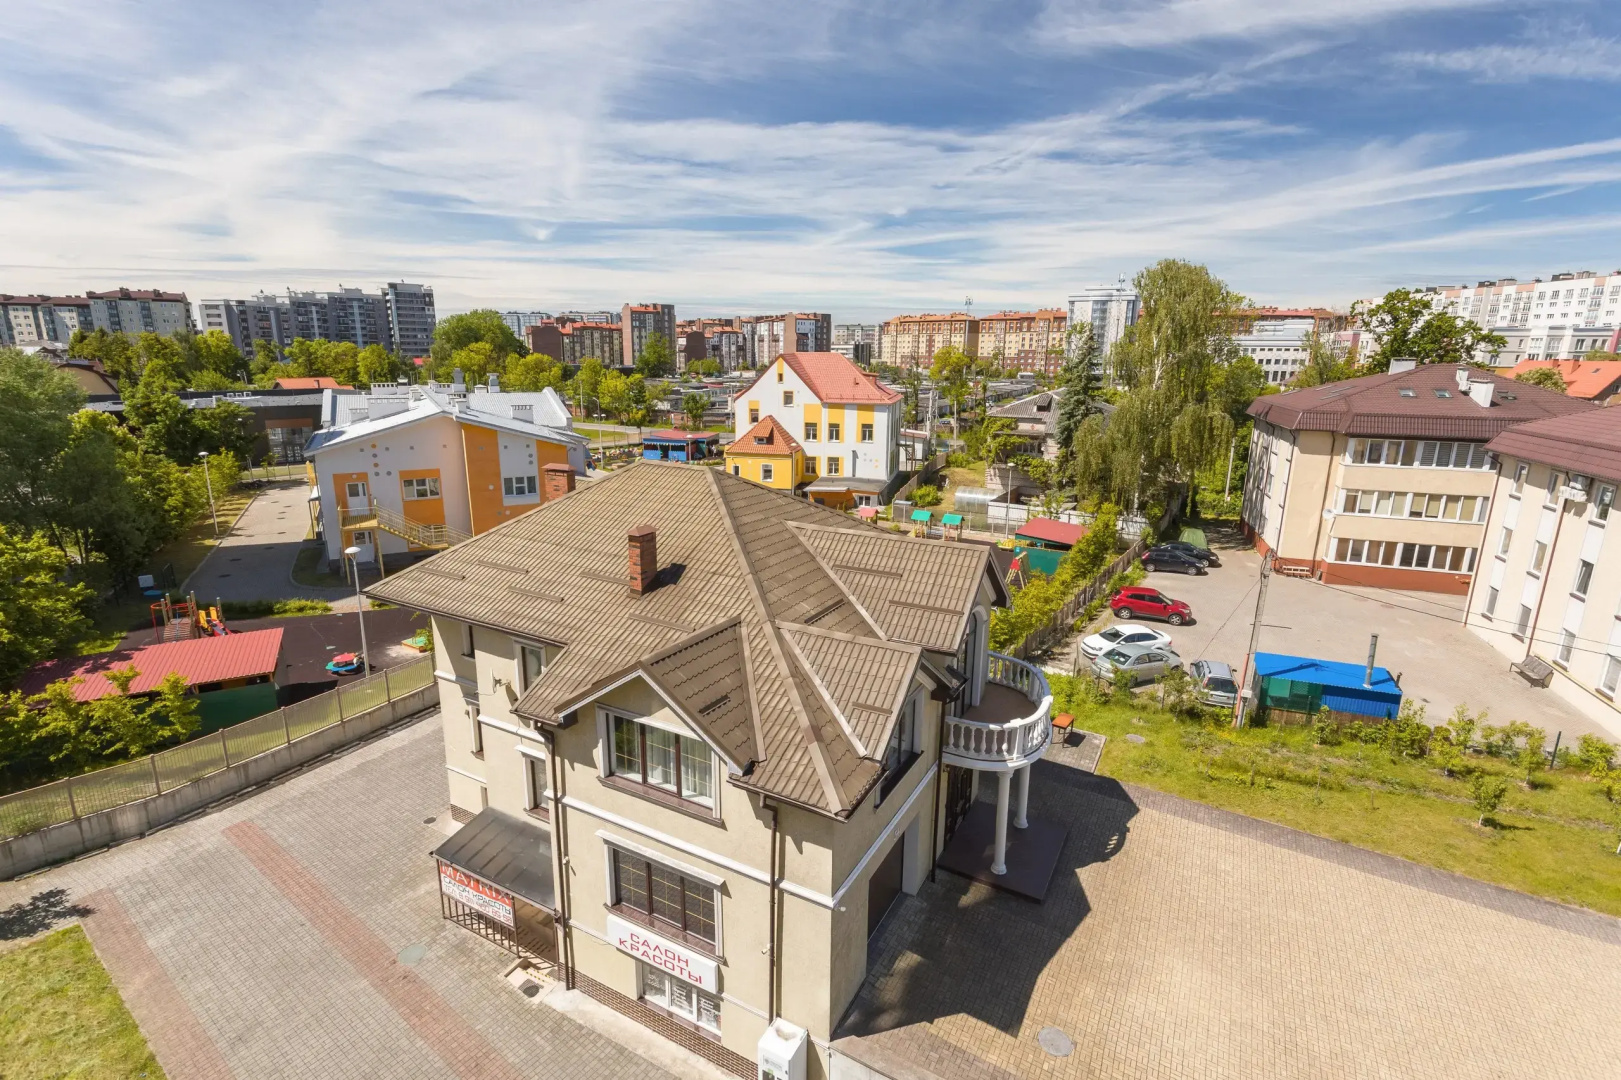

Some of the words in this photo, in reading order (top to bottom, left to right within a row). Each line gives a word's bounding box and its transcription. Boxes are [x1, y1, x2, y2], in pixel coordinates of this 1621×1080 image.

[440, 861, 510, 905] MATRIX
[443, 875, 470, 894] САЛОН
[472, 891, 512, 915] КРАСОТЫ
[619, 938, 702, 984] КРАСОТЫ
[630, 933, 689, 968] САЛОН
